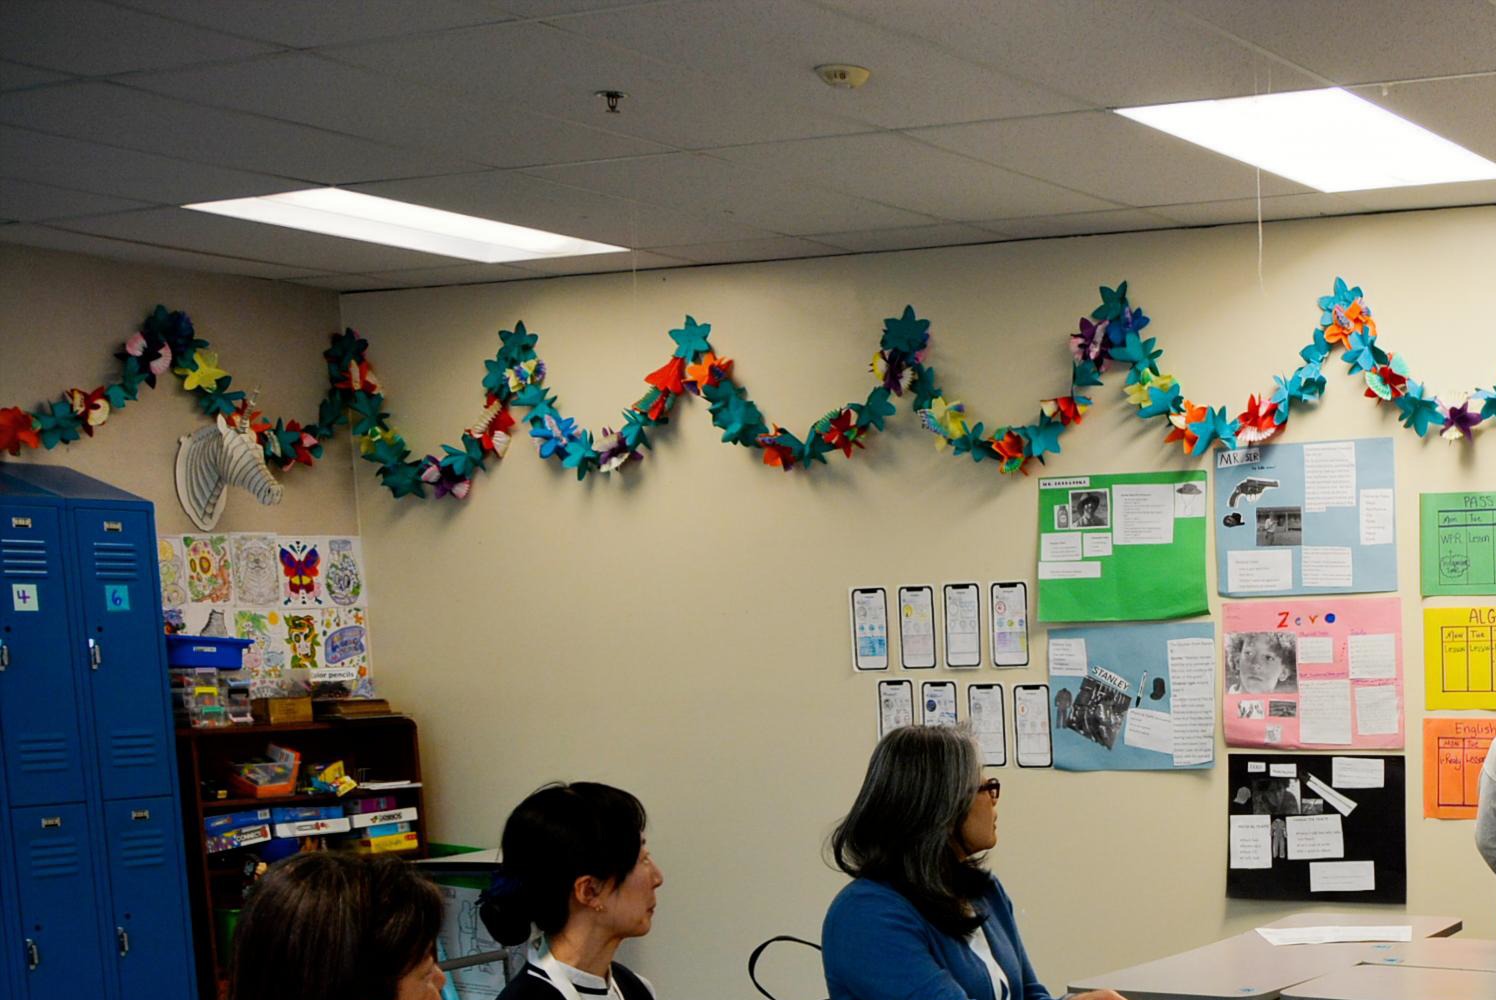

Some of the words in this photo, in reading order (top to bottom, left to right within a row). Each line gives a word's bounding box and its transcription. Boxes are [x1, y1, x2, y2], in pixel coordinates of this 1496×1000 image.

[1464, 496, 1494, 508] PASS
[16, 590, 31, 604] 4
[111, 590, 122, 606] 6
[328, 671, 354, 679] pencils
[1092, 666, 1129, 690] STANLEY
